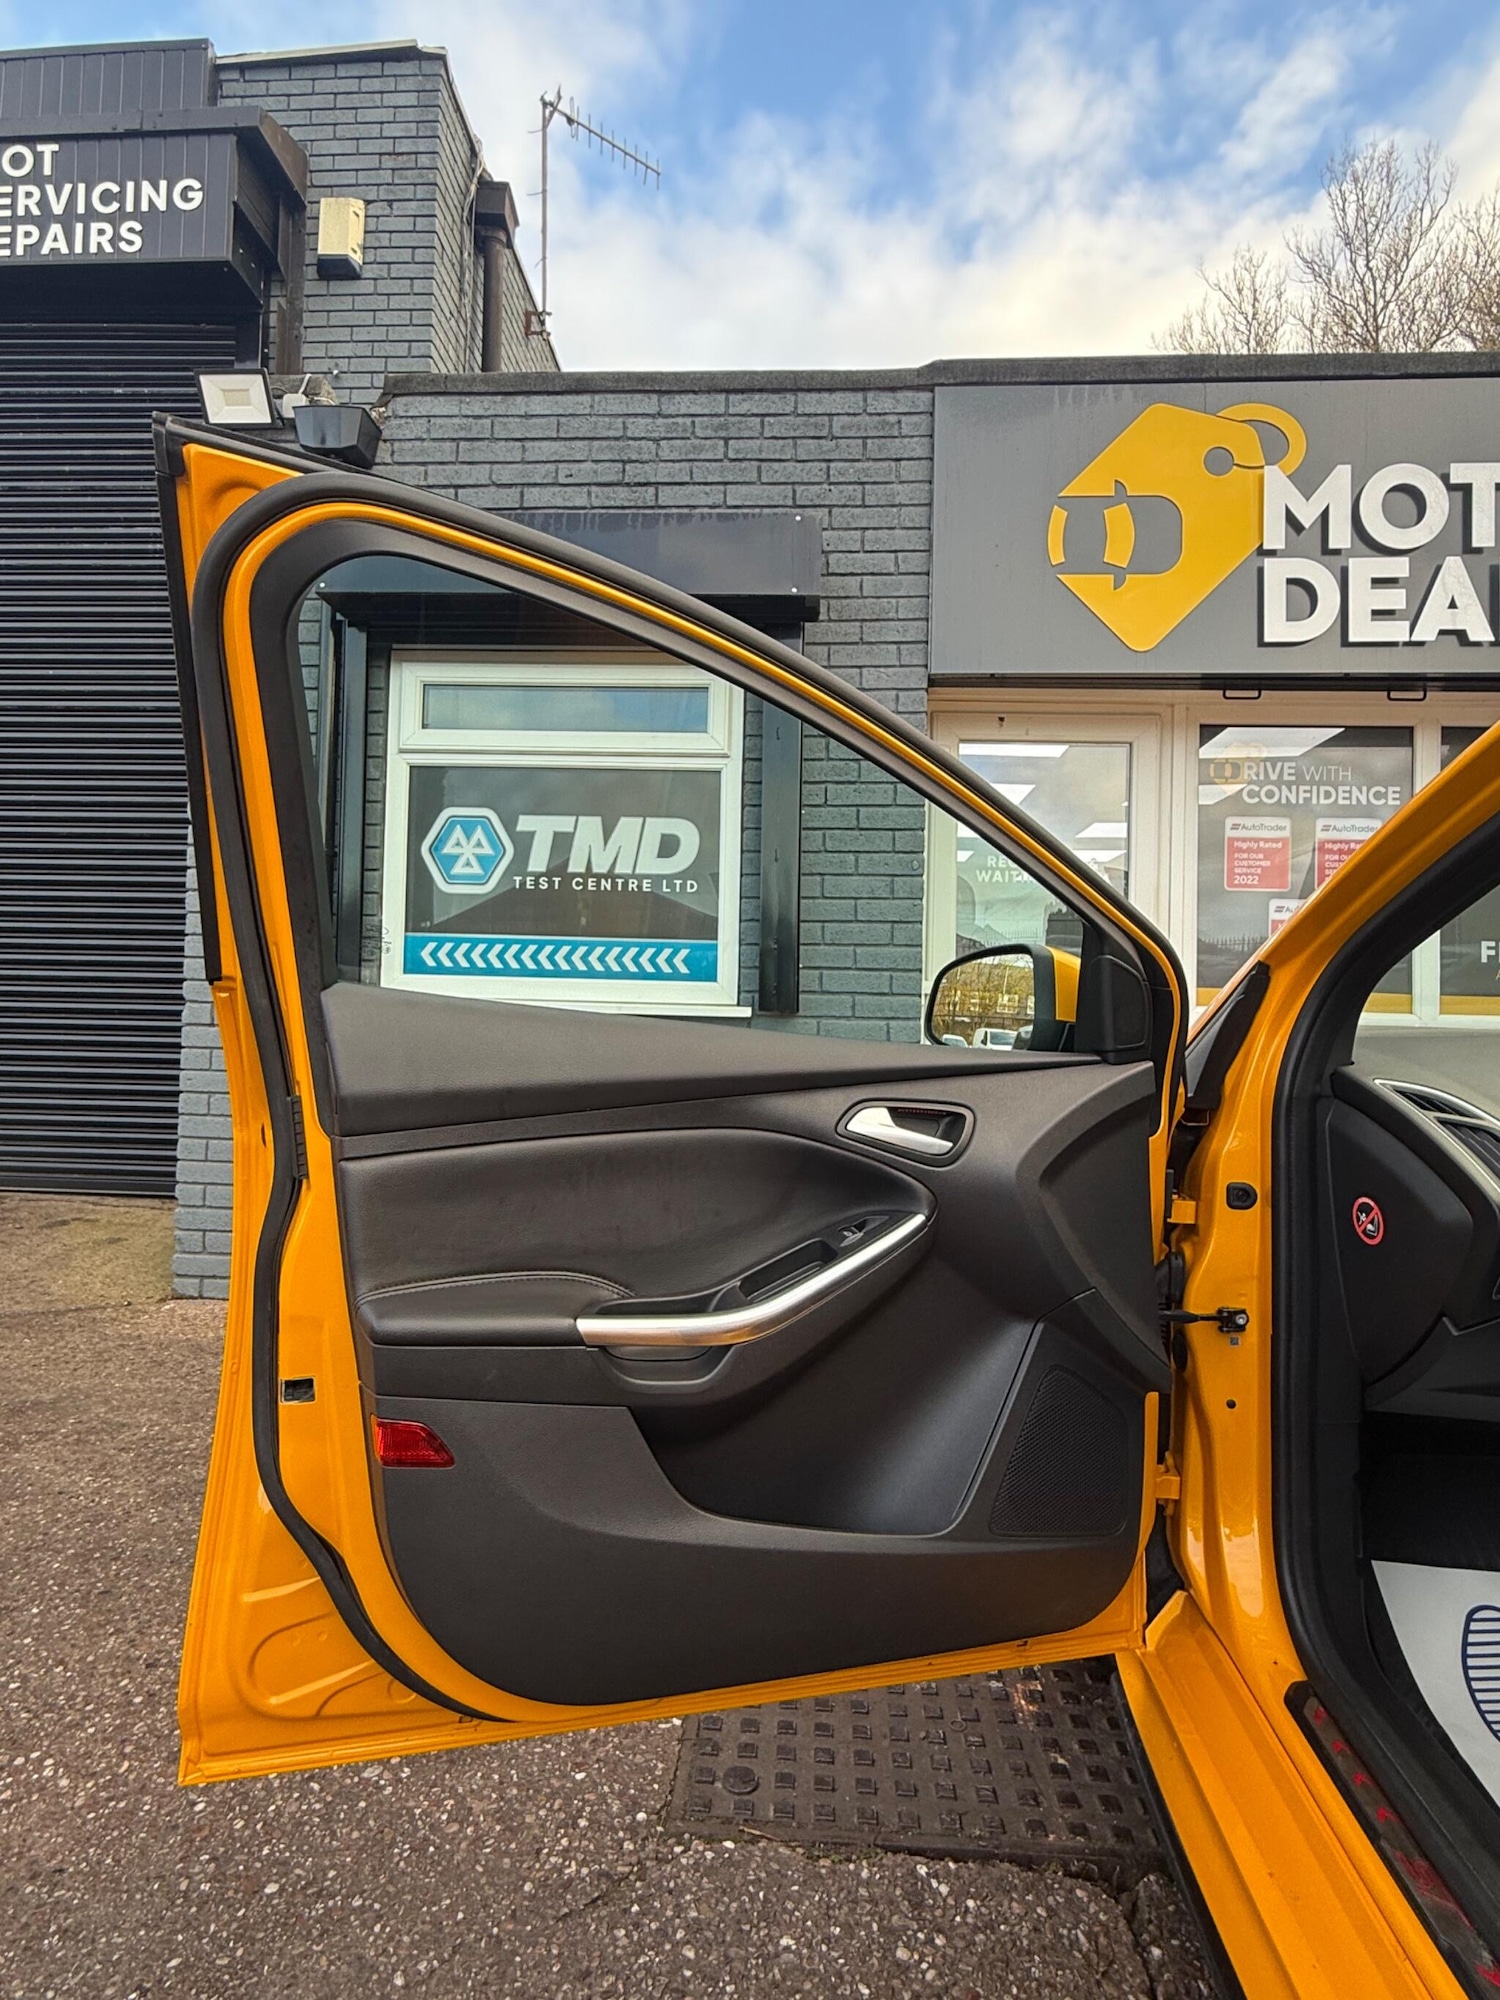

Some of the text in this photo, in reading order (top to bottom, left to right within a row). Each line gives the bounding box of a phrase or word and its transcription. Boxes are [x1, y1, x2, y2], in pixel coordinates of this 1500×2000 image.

[0, 220, 144, 257] EPAIRS
[1263, 463, 1500, 549] MOT
[1303, 765, 1352, 782] WITH
[1242, 784, 1401, 806] CONFIDENCE
[515, 814, 701, 875] TMD
[1233, 840, 1259, 850] Highly
[1324, 842, 1350, 851] Highly
[513, 876, 699, 893] TEST CENTRE LTD
[1233, 875, 1259, 885] 2022
